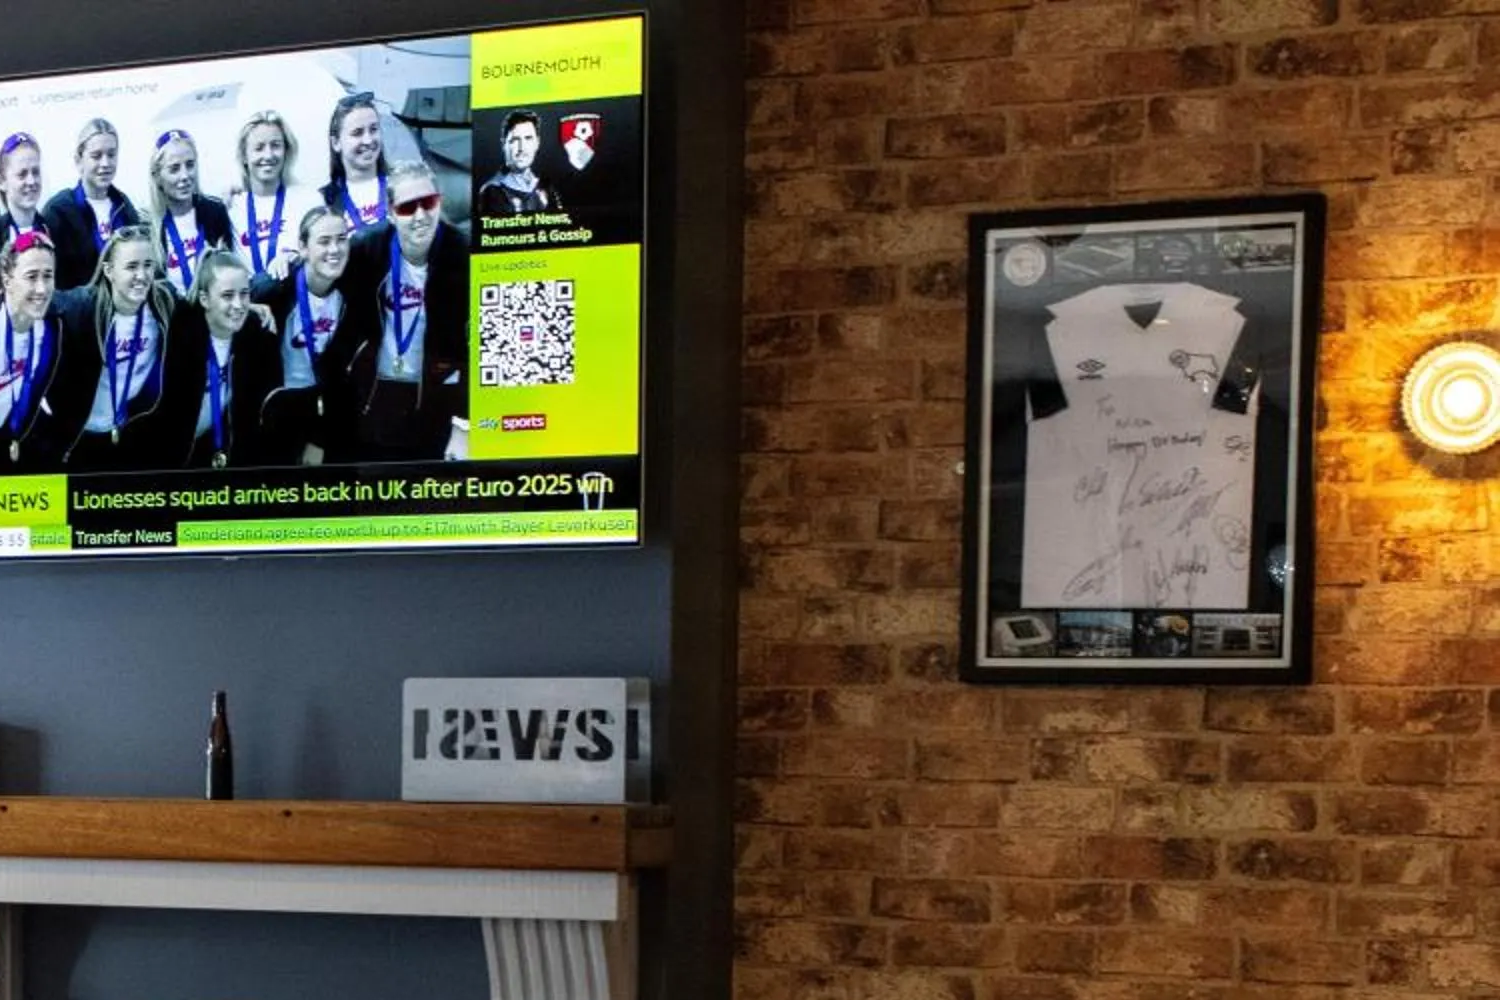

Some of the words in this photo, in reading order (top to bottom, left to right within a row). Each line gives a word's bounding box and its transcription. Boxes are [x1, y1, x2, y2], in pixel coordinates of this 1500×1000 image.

[481, 56, 601, 79] BOURNEMOUTH
[481, 214, 533, 229] Transfer
[535, 213, 572, 227] News,
[481, 231, 535, 246] Rumours
[538, 230, 548, 242] &
[550, 227, 593, 242] Gossip
[502, 416, 546, 430] sports
[73, 490, 166, 511] Lionesses
[169, 485, 230, 511] squad
[234, 483, 299, 506] arrives
[303, 481, 352, 503] back
[355, 480, 373, 501] in
[377, 479, 408, 501] UK
[411, 476, 462, 500] after
[466, 477, 515, 498] Euro
[517, 474, 572, 497] 2025
[576, 474, 614, 496] win
[75, 530, 133, 545] Transfer
[135, 529, 172, 544] News
[183, 527, 263, 541] Sunderland
[265, 527, 305, 543] agree
[308, 525, 333, 539] fee
[381, 524, 401, 540] up
[403, 523, 421, 537] to
[501, 518, 545, 536] Bayer
[548, 516, 635, 533] Leverkusen
